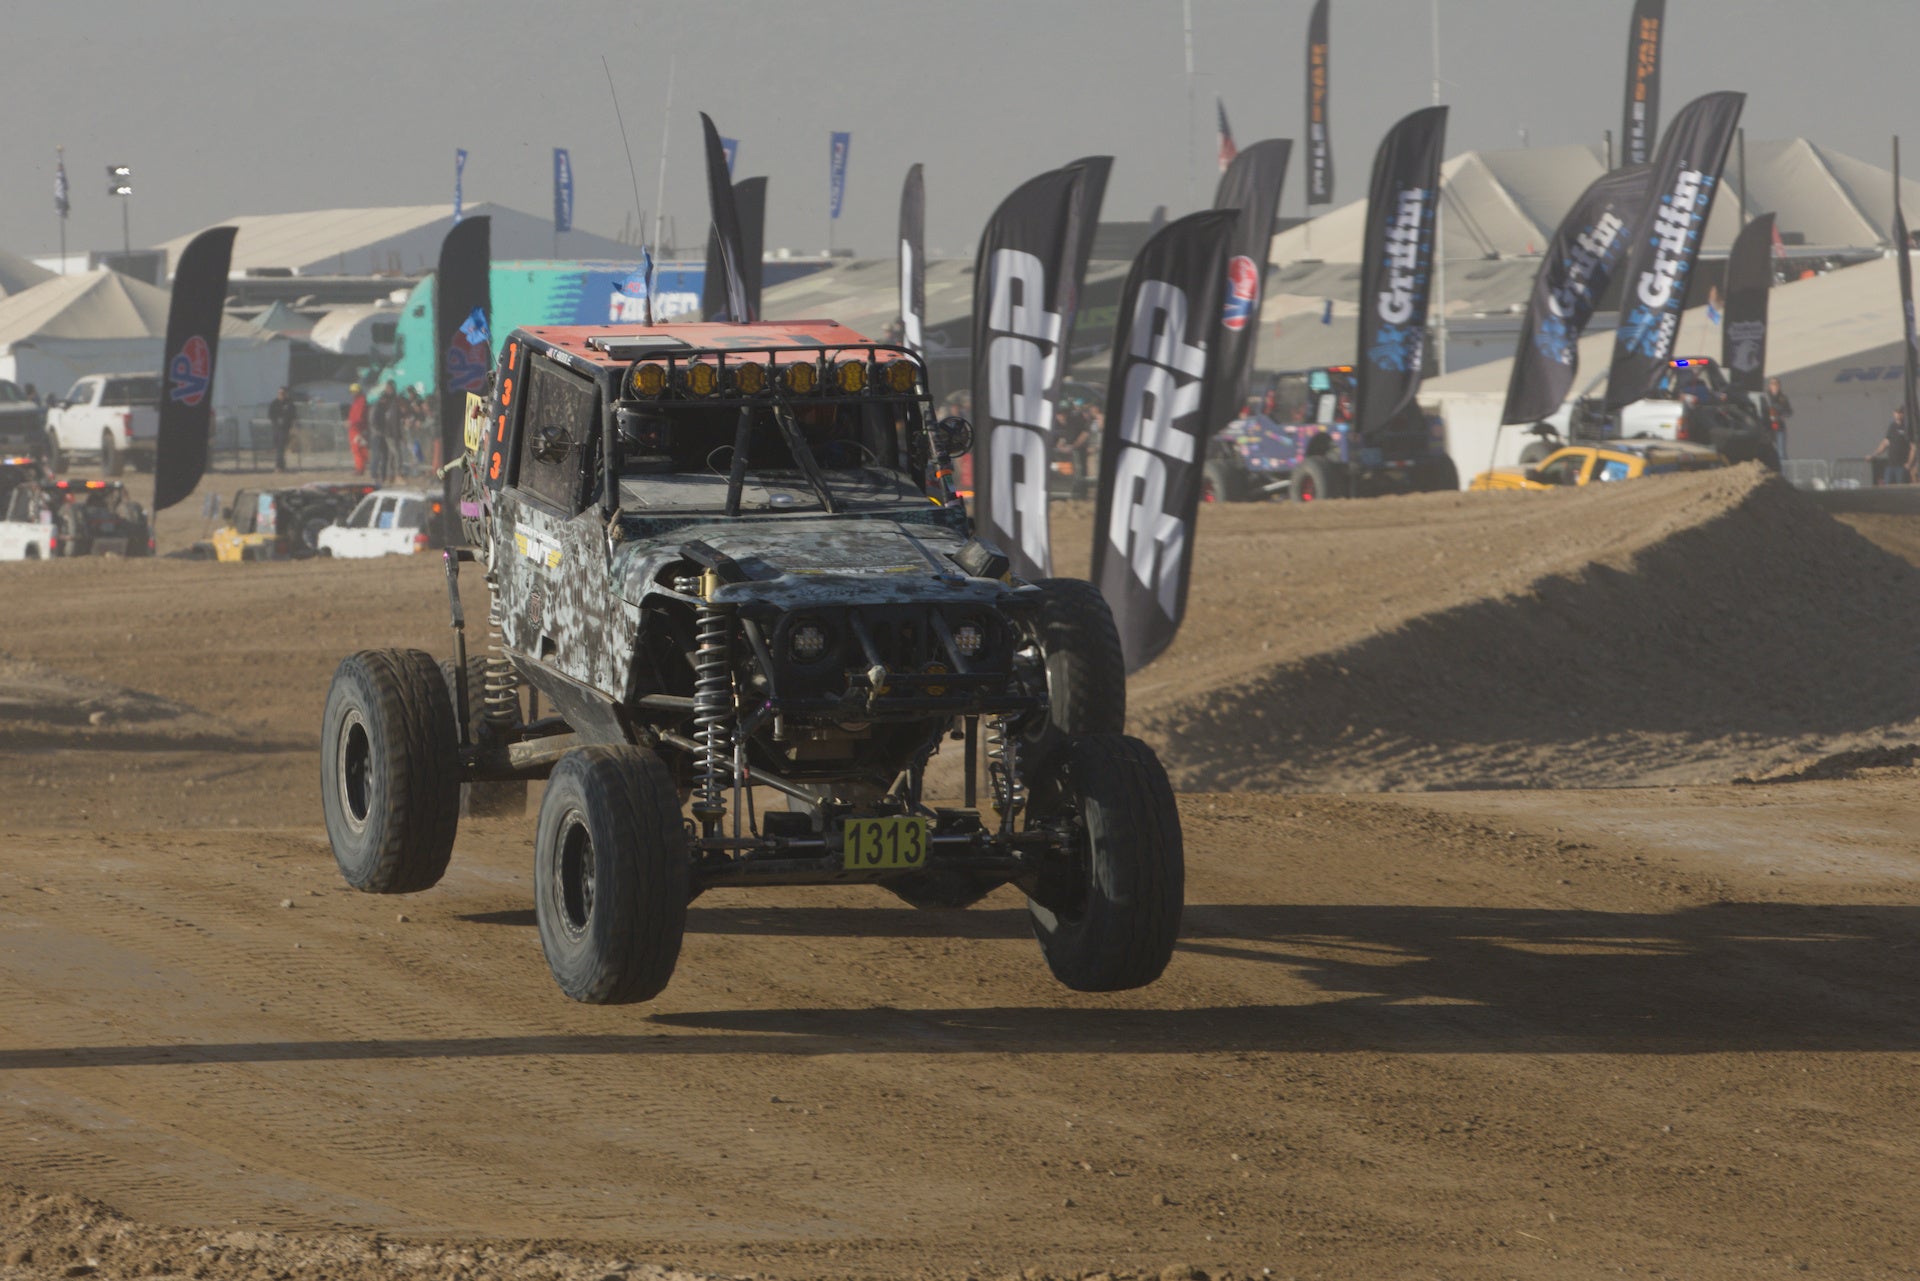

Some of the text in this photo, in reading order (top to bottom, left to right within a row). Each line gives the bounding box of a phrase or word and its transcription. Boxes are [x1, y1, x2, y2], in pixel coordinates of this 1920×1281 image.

[1378, 187, 1422, 324] Griffin
[1637, 169, 1702, 308] Griffin
[1666, 174, 1714, 310] RADIATOR
[989, 248, 1062, 570] ARP
[1109, 280, 1207, 622] ARP
[848, 821, 921, 865] 1313
